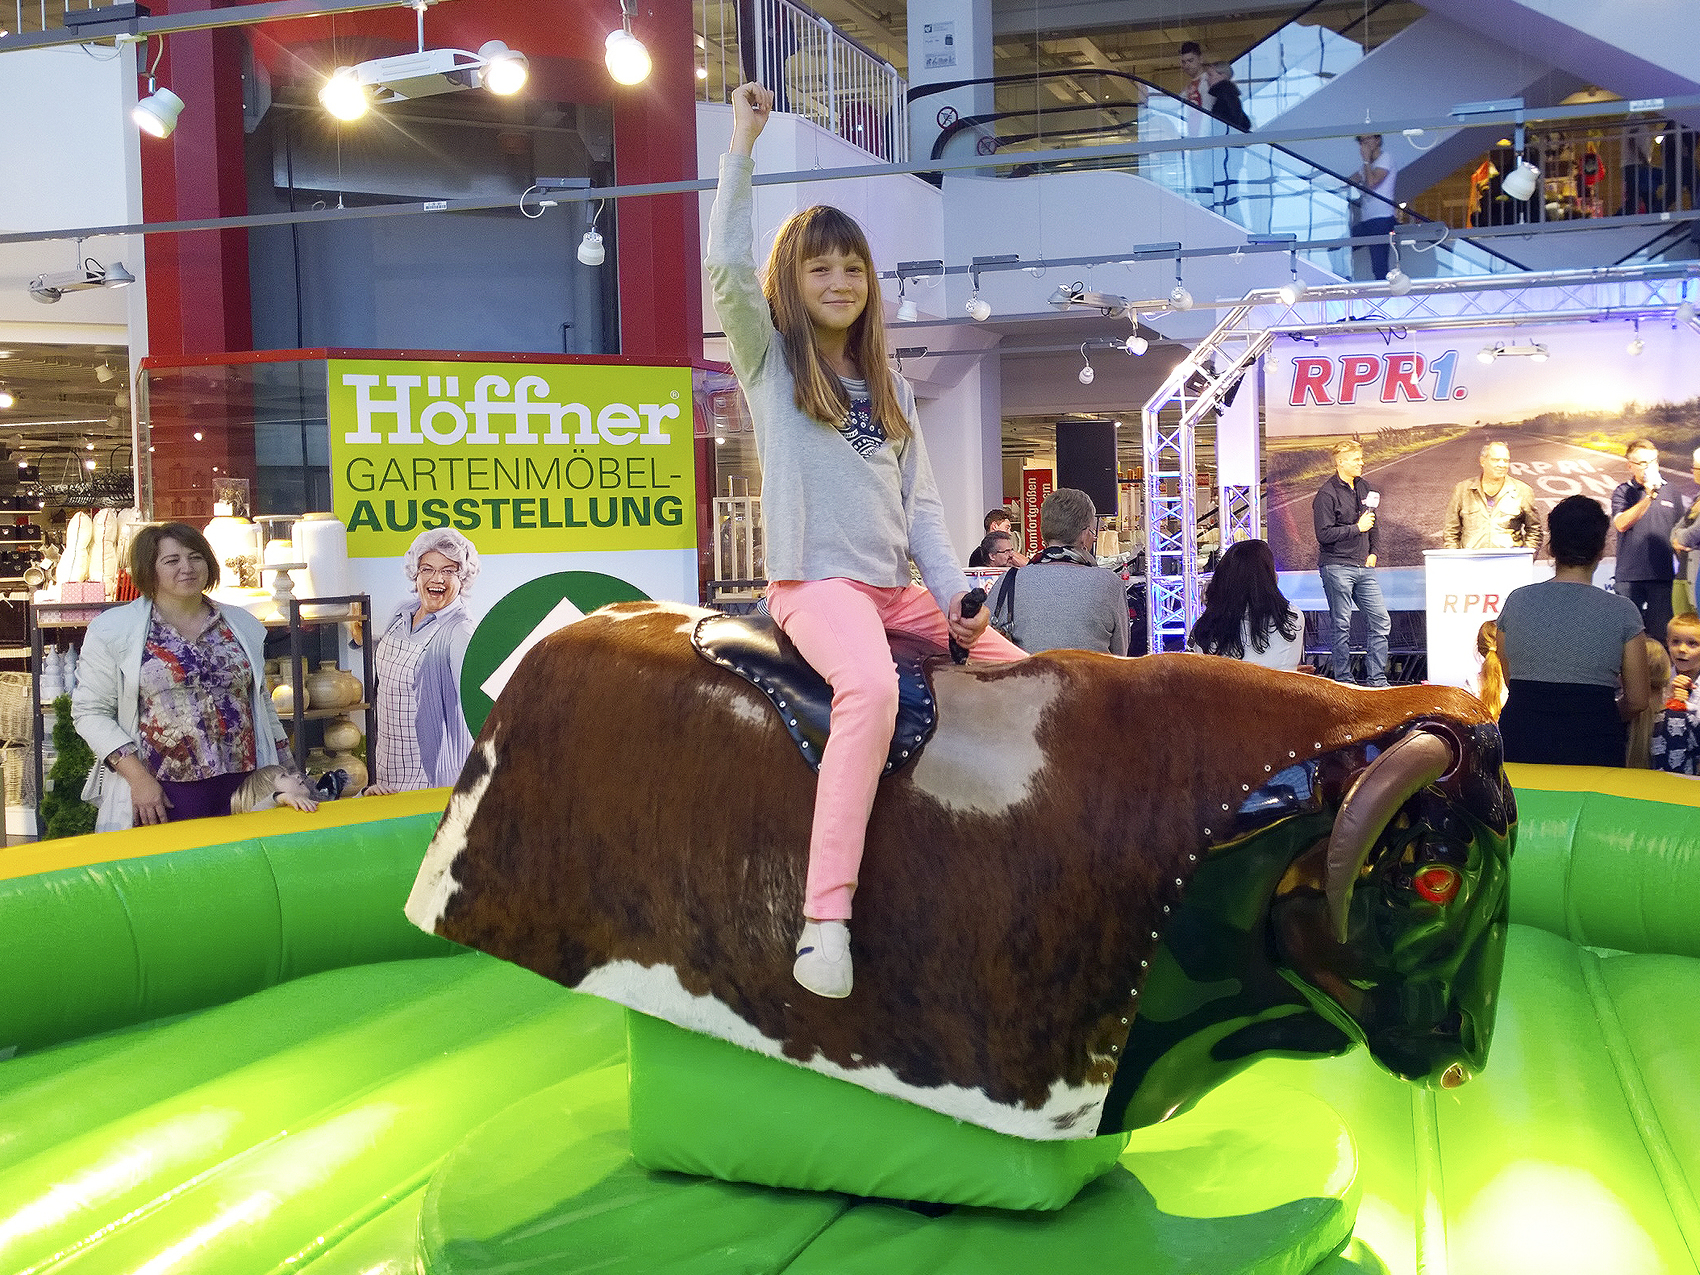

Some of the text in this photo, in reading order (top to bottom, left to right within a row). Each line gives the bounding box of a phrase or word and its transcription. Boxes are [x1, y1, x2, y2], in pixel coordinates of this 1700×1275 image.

[1289, 350, 1468, 406] RPR1.
[342, 374, 681, 446] Höffner
[346, 449, 682, 492] GARTENMÖBEL-
[346, 496, 683, 532] AUSSTELLUNG
[1443, 594, 1505, 613] RPR
